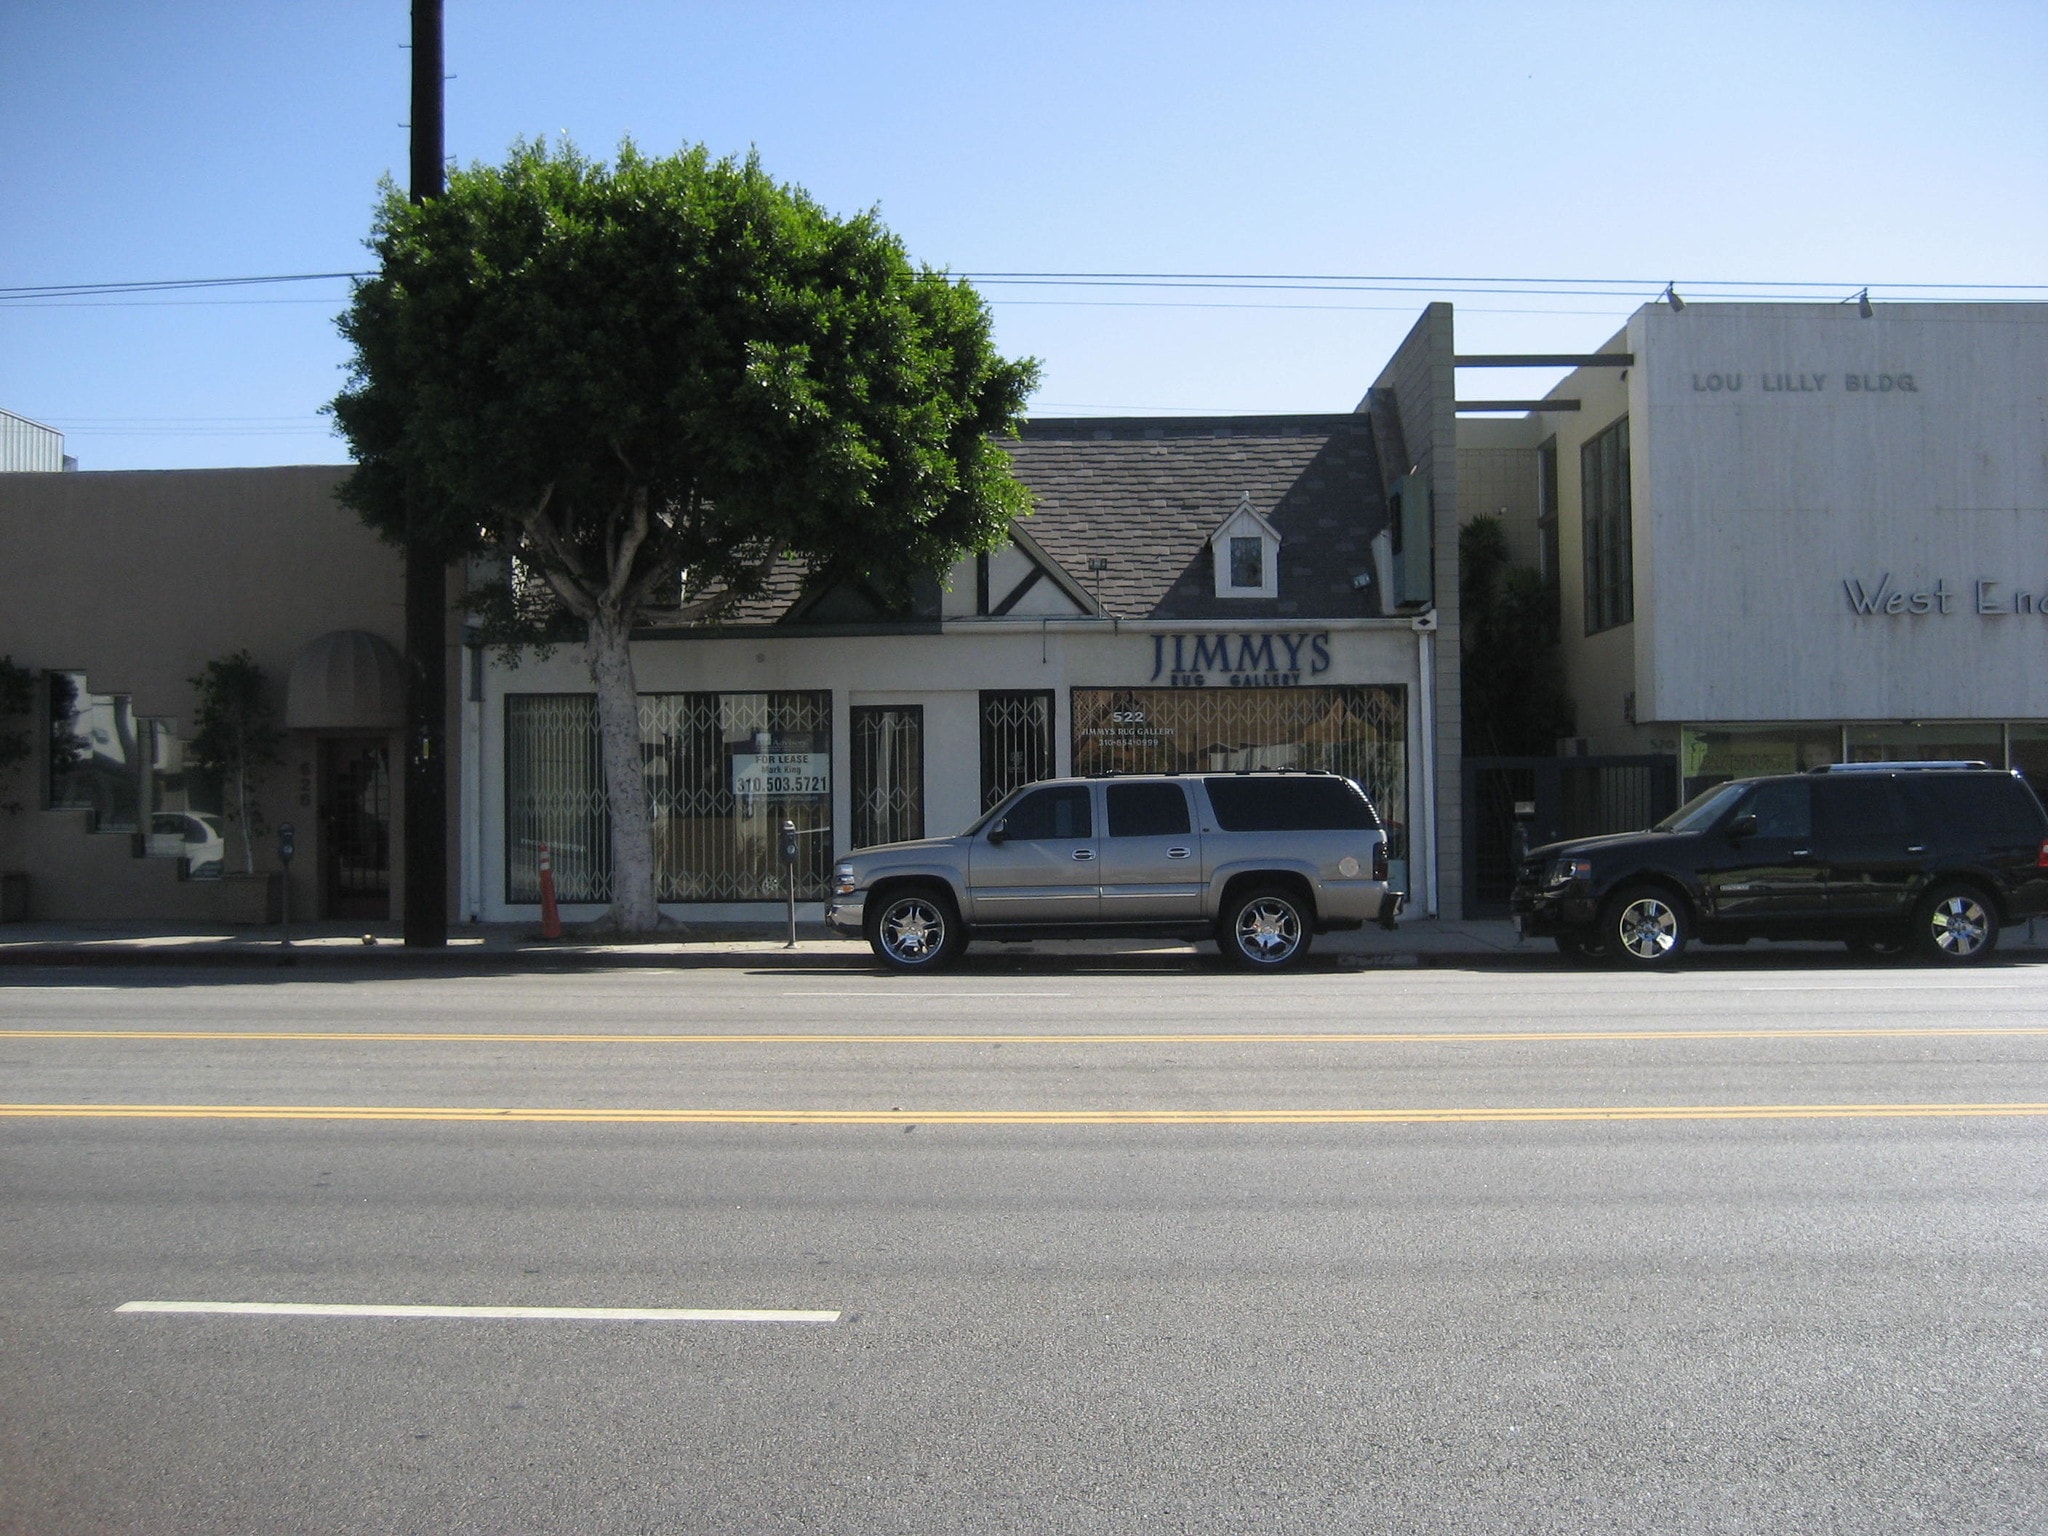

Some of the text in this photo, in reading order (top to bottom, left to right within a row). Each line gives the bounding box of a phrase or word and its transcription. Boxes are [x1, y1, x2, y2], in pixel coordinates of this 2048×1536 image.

[1693, 373, 1743, 392] LOU
[1762, 373, 1827, 392] LILLY
[1843, 572, 1953, 615] West
[1150, 630, 1331, 682] JIMMYS
[1171, 673, 1301, 686] RUG GALLERY
[1113, 711, 1144, 722] 522
[1082, 728, 1175, 736] JIMMYS RUG GALLERY
[755, 755, 809, 764] FOR LEASE
[736, 776, 827, 792] 310.503.5721
